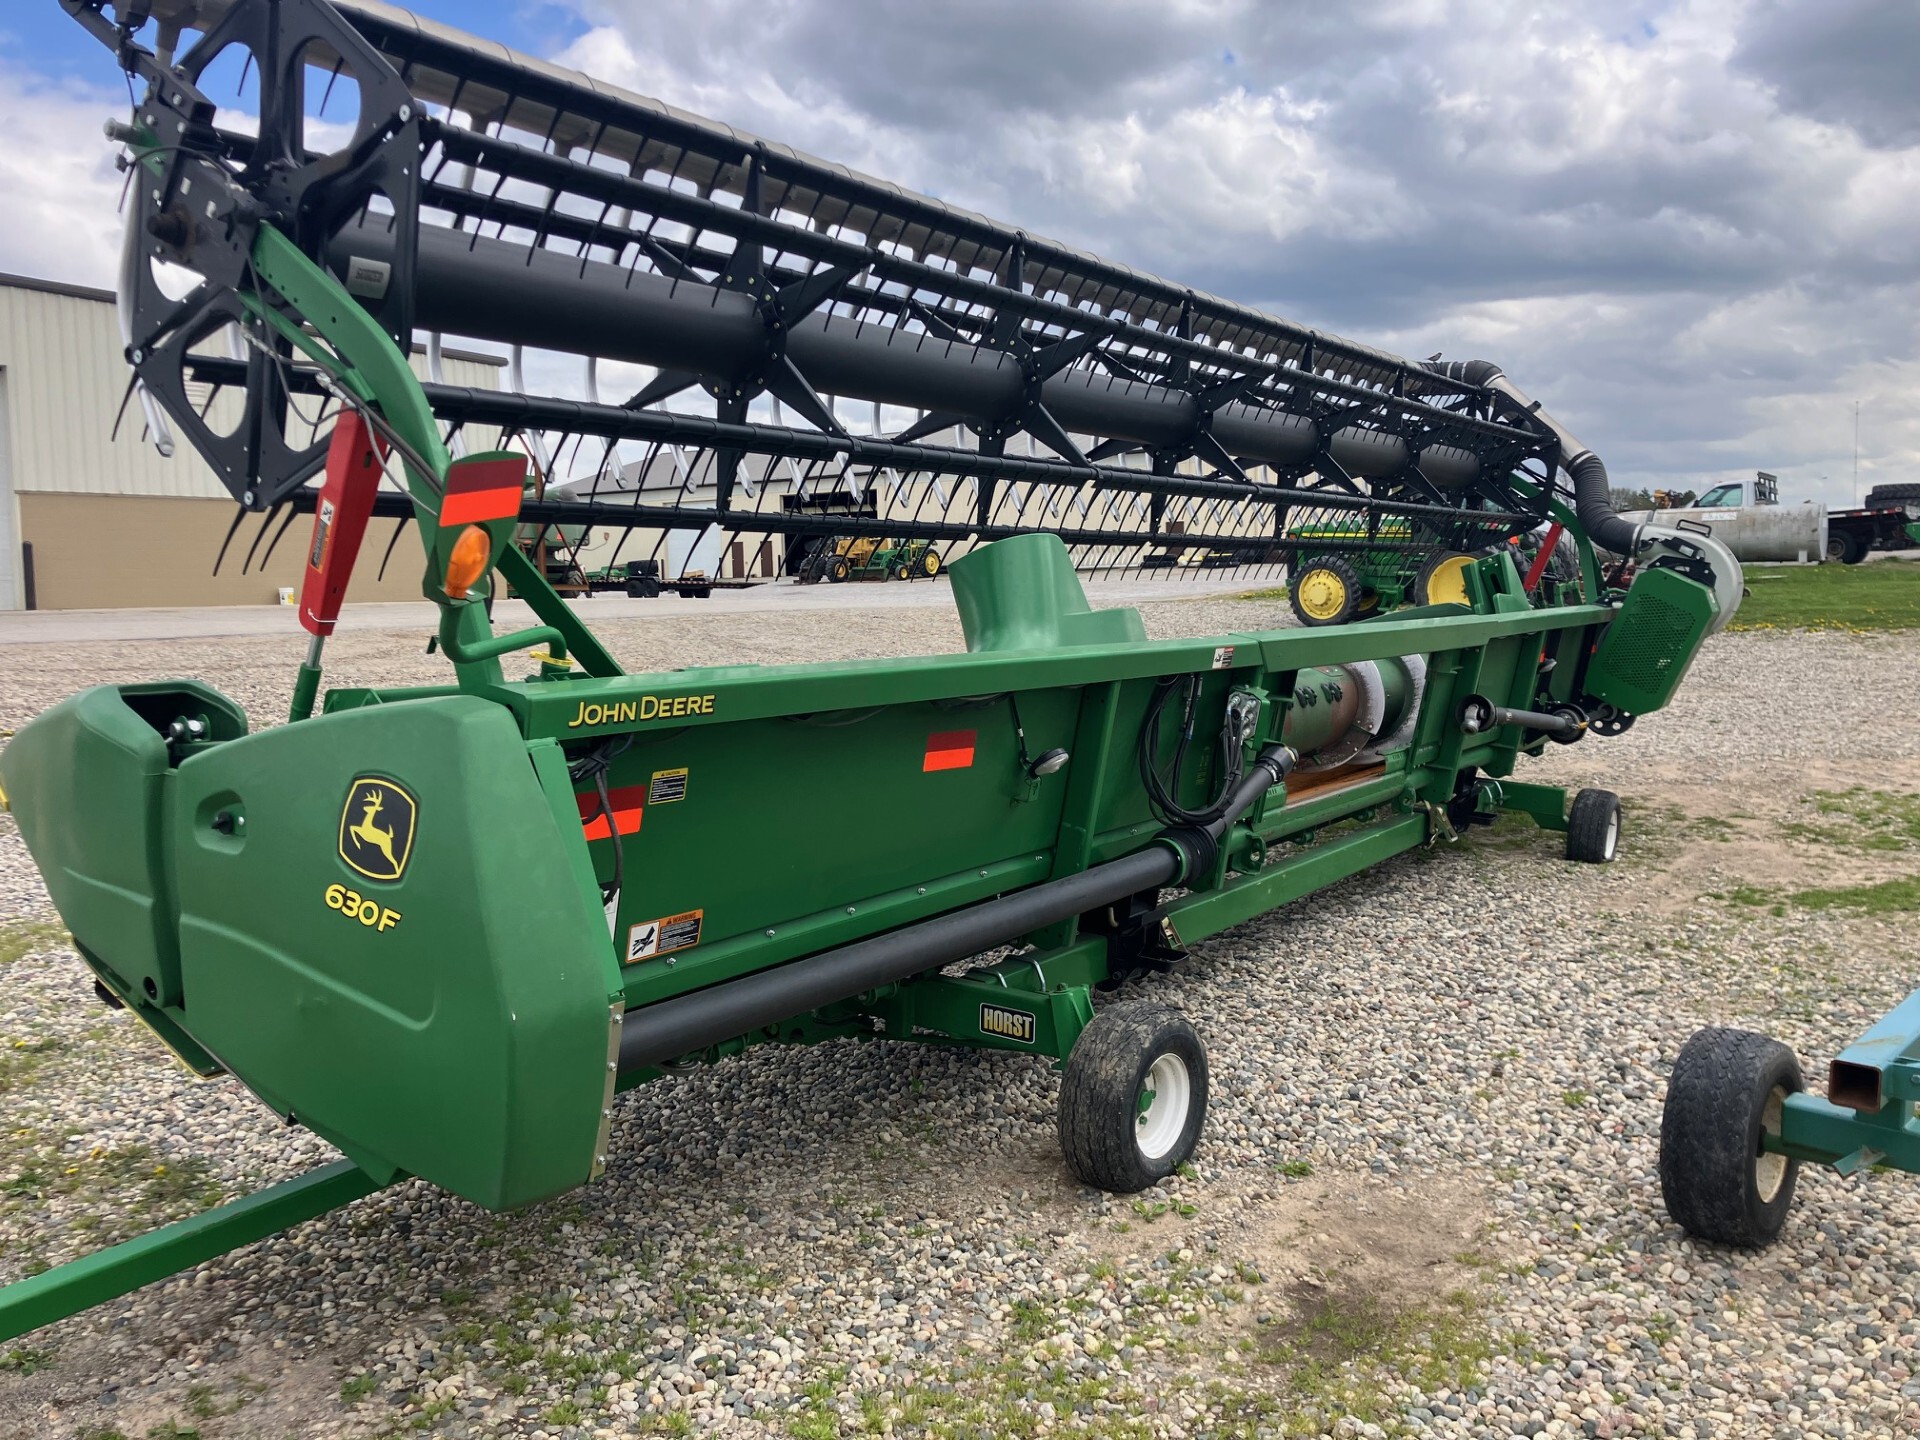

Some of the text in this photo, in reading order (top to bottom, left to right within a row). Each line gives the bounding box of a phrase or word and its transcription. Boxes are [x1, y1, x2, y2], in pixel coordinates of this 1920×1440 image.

[568, 694, 716, 728] JOHN DEERE
[324, 883, 402, 933] 630F
[983, 1007, 1033, 1039] HORST
